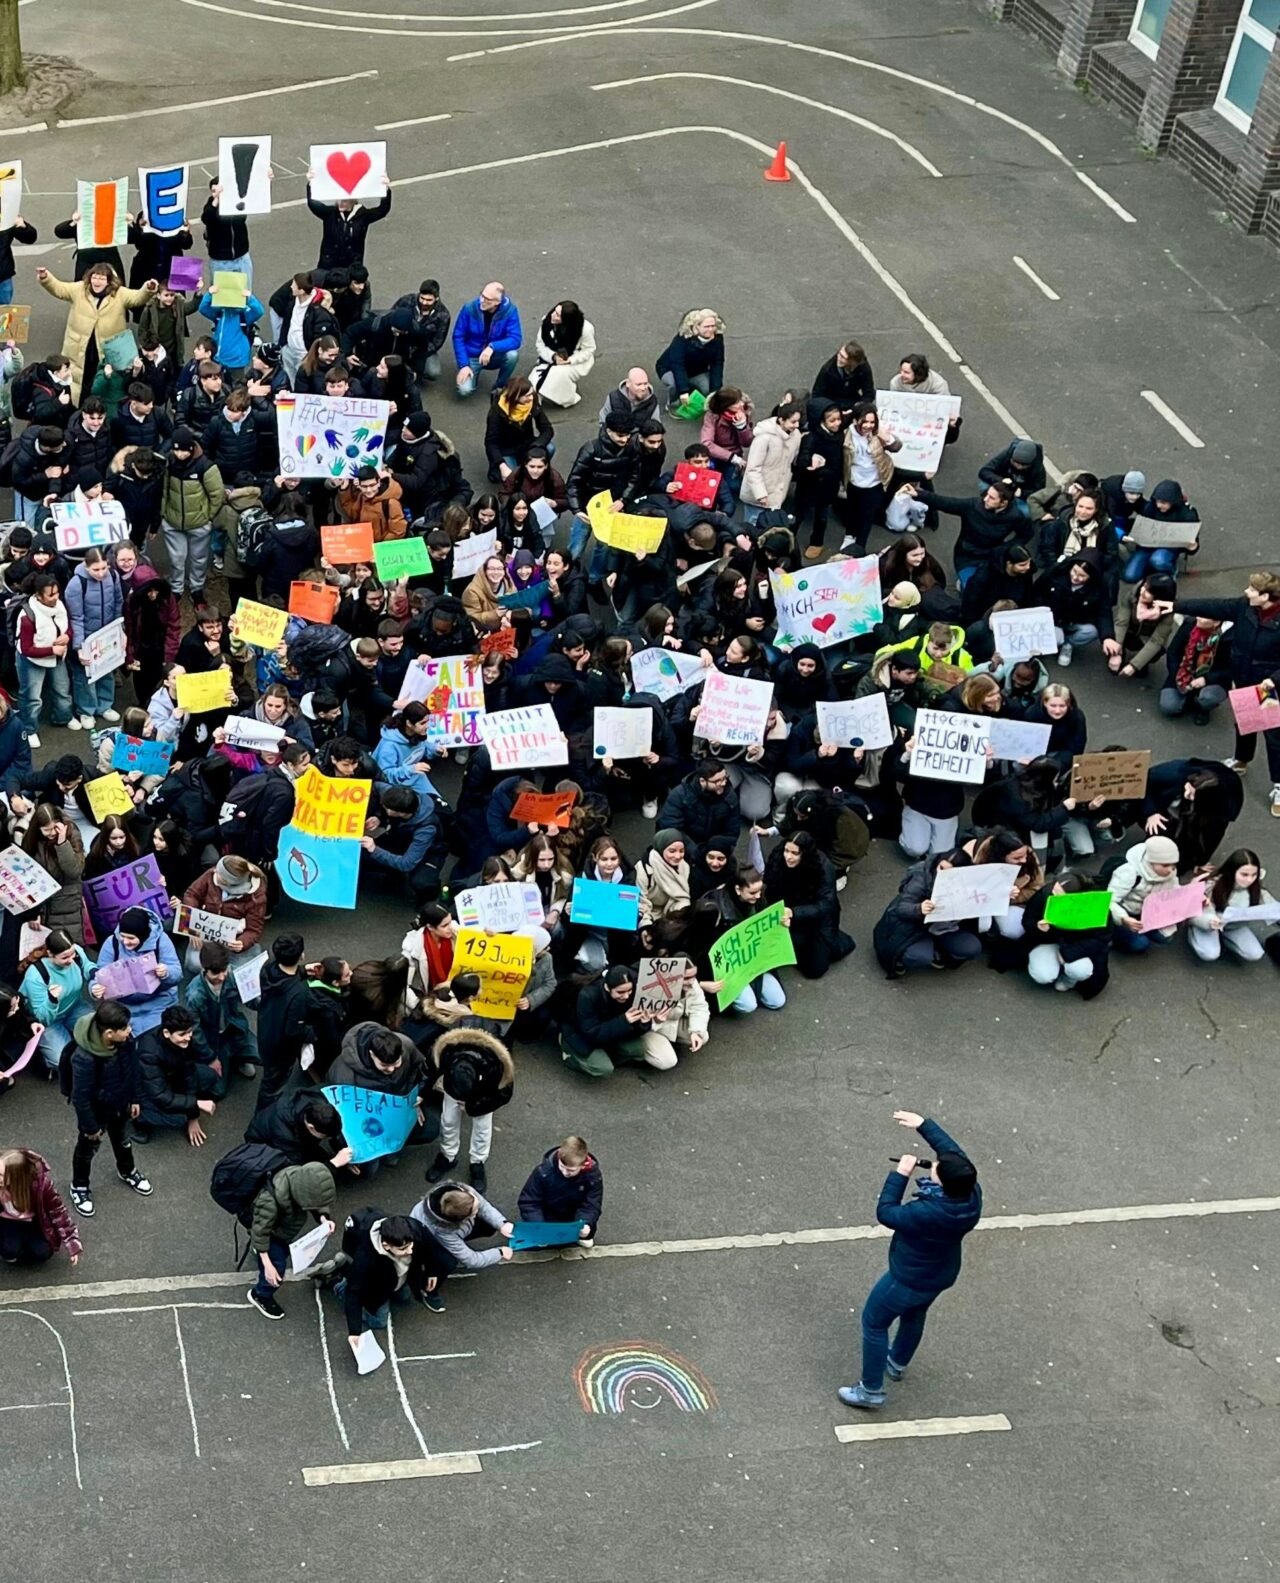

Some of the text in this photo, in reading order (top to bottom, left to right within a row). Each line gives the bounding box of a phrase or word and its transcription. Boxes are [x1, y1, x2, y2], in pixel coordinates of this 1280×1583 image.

[145, 166, 185, 232] E
[343, 399, 380, 416] STEH
[64, 522, 125, 546] DEN
[917, 726, 990, 757] RELIGIONS
[914, 748, 972, 775] FREIHEIT
[294, 797, 361, 835] KRATIE
[88, 861, 156, 909] FÜR
[744, 910, 782, 942] STEH
[489, 944, 527, 968] Juni
[647, 959, 678, 976] STOP
[491, 968, 526, 986] DER
[639, 998, 685, 1013] RACISM
[354, 1102, 384, 1117] FÜR
